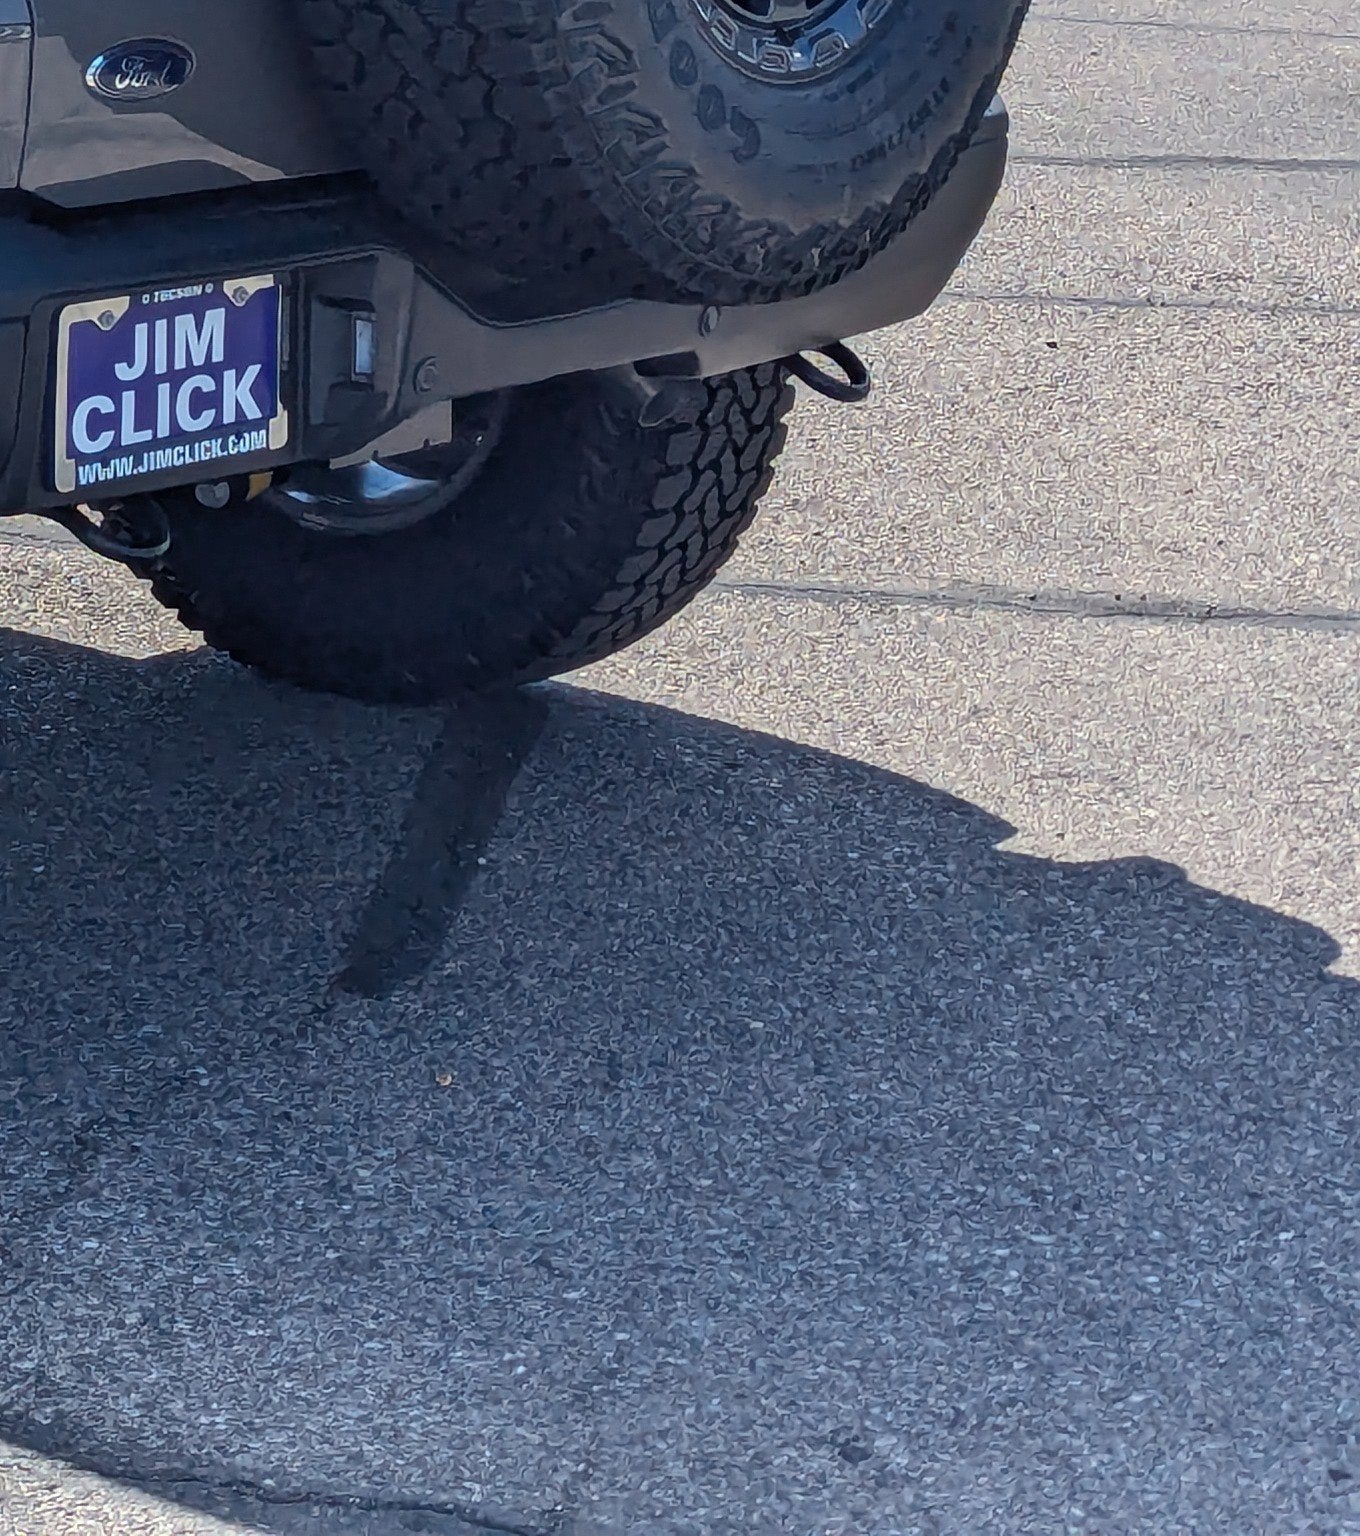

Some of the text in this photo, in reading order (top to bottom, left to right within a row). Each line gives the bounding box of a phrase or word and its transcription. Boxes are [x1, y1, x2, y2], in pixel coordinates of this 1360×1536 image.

[114, 307, 226, 381] JIM
[72, 364, 263, 454] CLICK
[77, 428, 267, 486] WWW.JIMCLICK.COM
